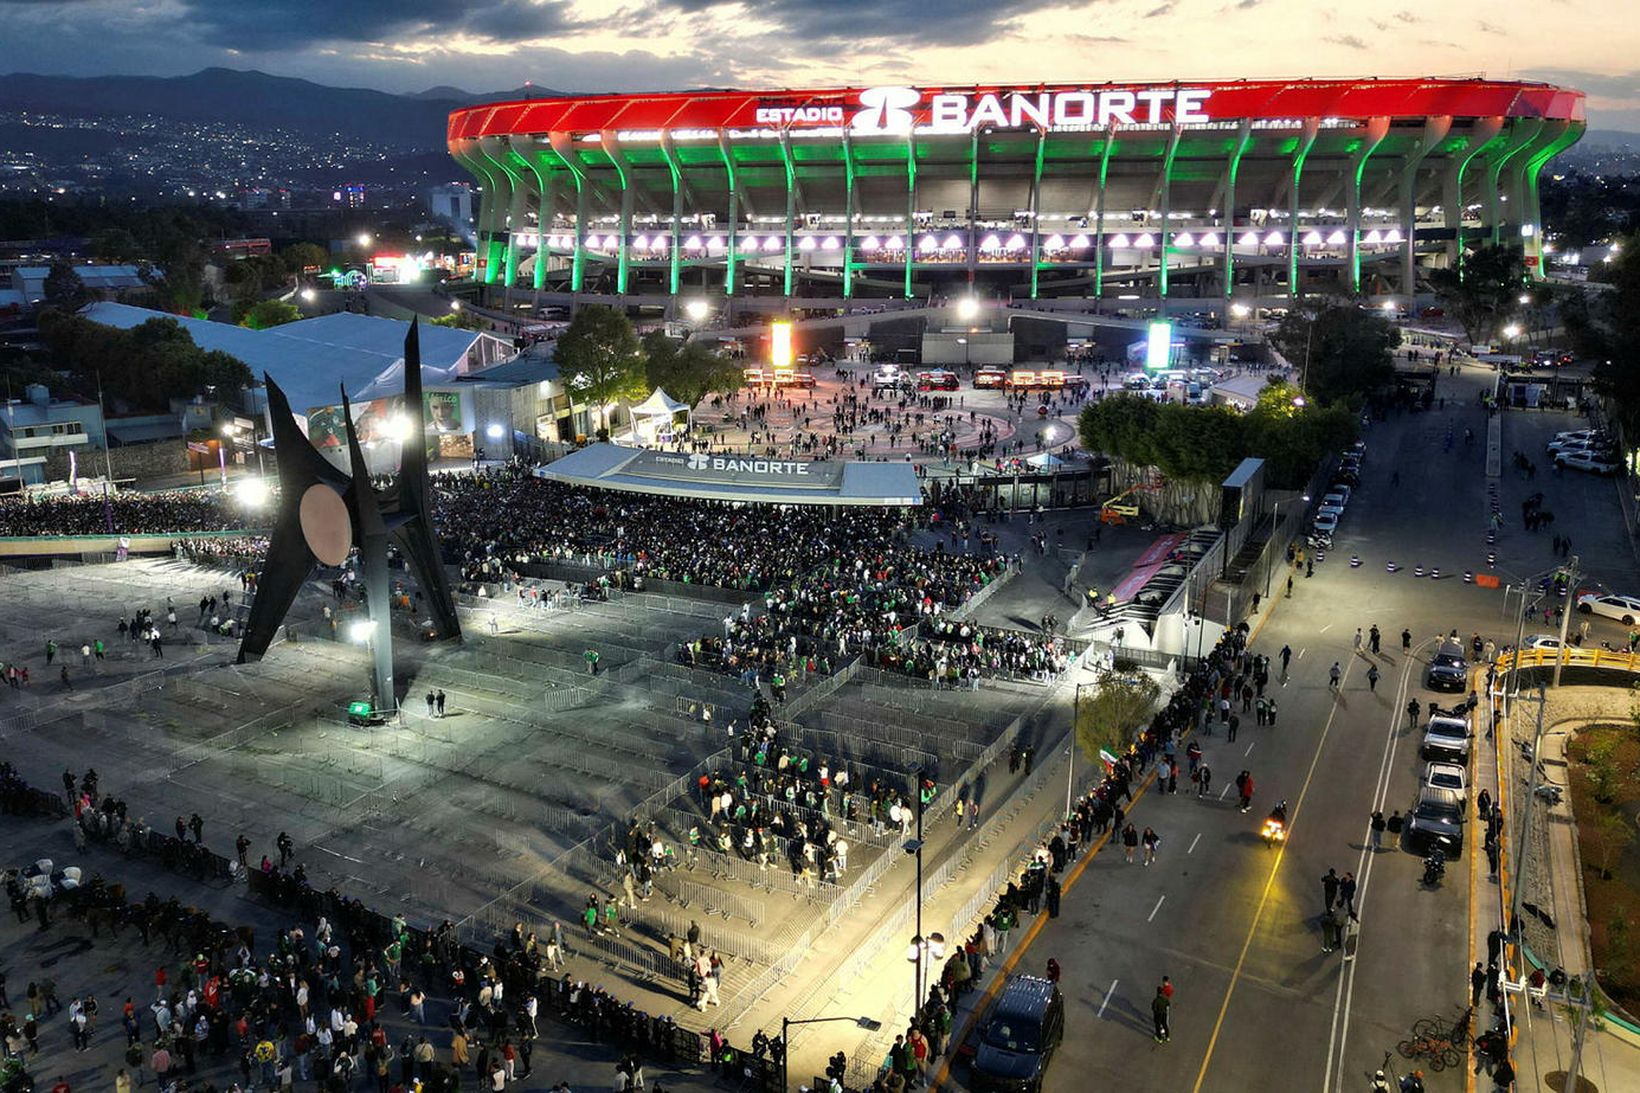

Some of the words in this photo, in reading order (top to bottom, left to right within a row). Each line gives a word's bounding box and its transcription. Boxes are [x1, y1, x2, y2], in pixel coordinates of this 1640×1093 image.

[755, 106, 844, 123] ESTADIO
[931, 89, 1213, 127] BANORTE
[713, 458, 809, 475] BANORTE
